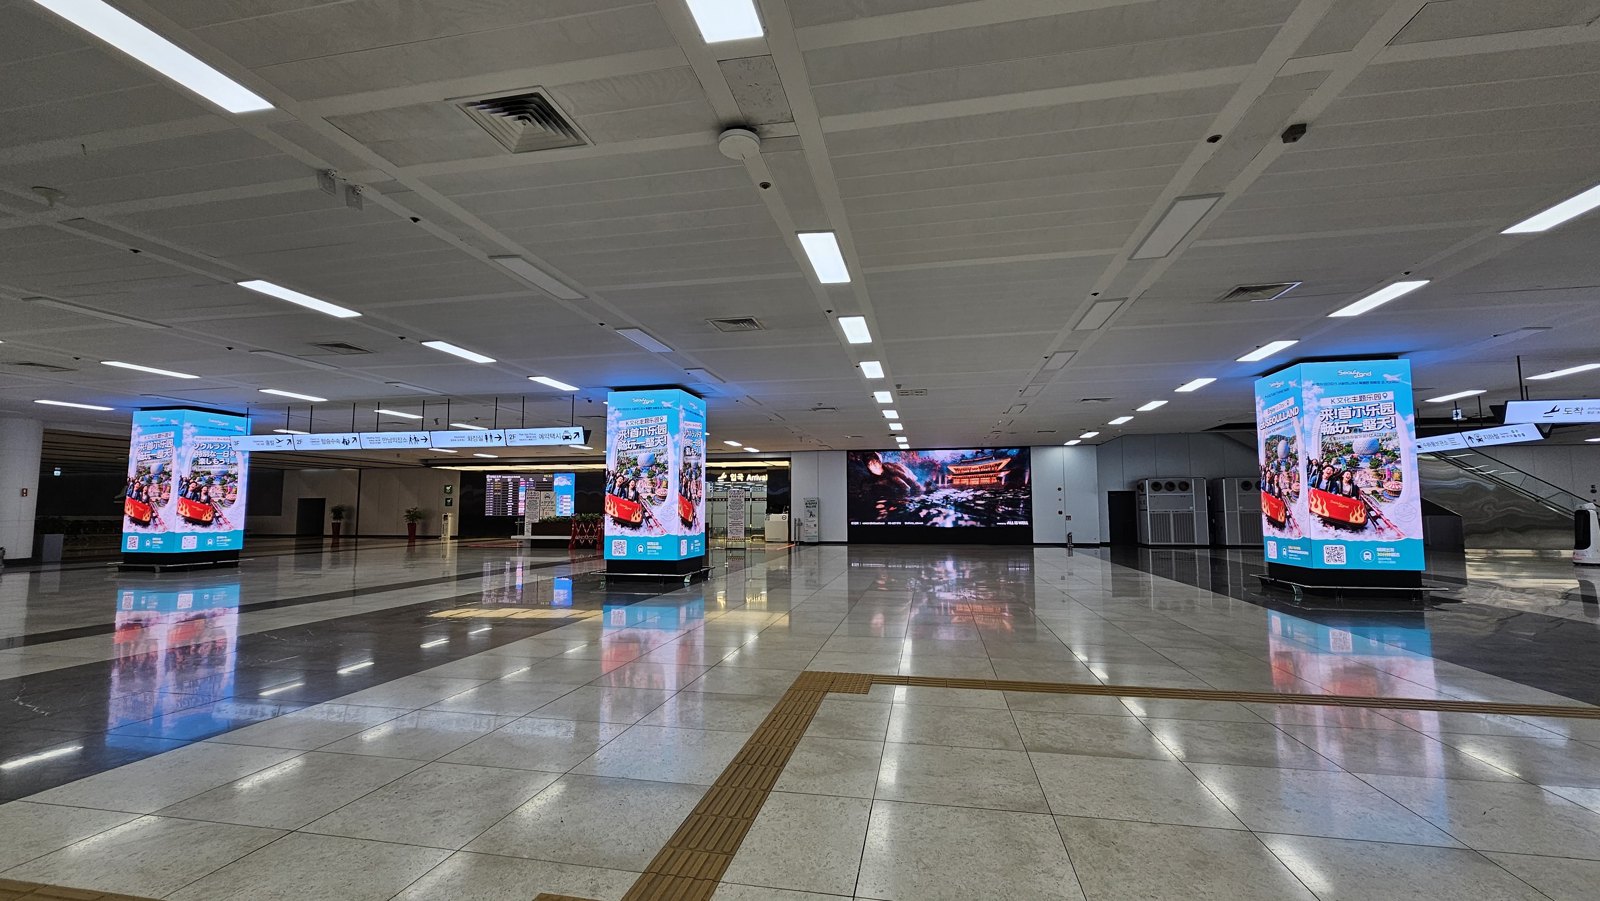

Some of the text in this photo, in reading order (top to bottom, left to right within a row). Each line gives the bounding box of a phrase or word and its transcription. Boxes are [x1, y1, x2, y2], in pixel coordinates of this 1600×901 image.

[1562, 406, 1584, 416] 도착
[467, 434, 484, 443] 화장실
[538, 432, 562, 440] 예약택시
[729, 473, 768, 482] 입국 Arrival
